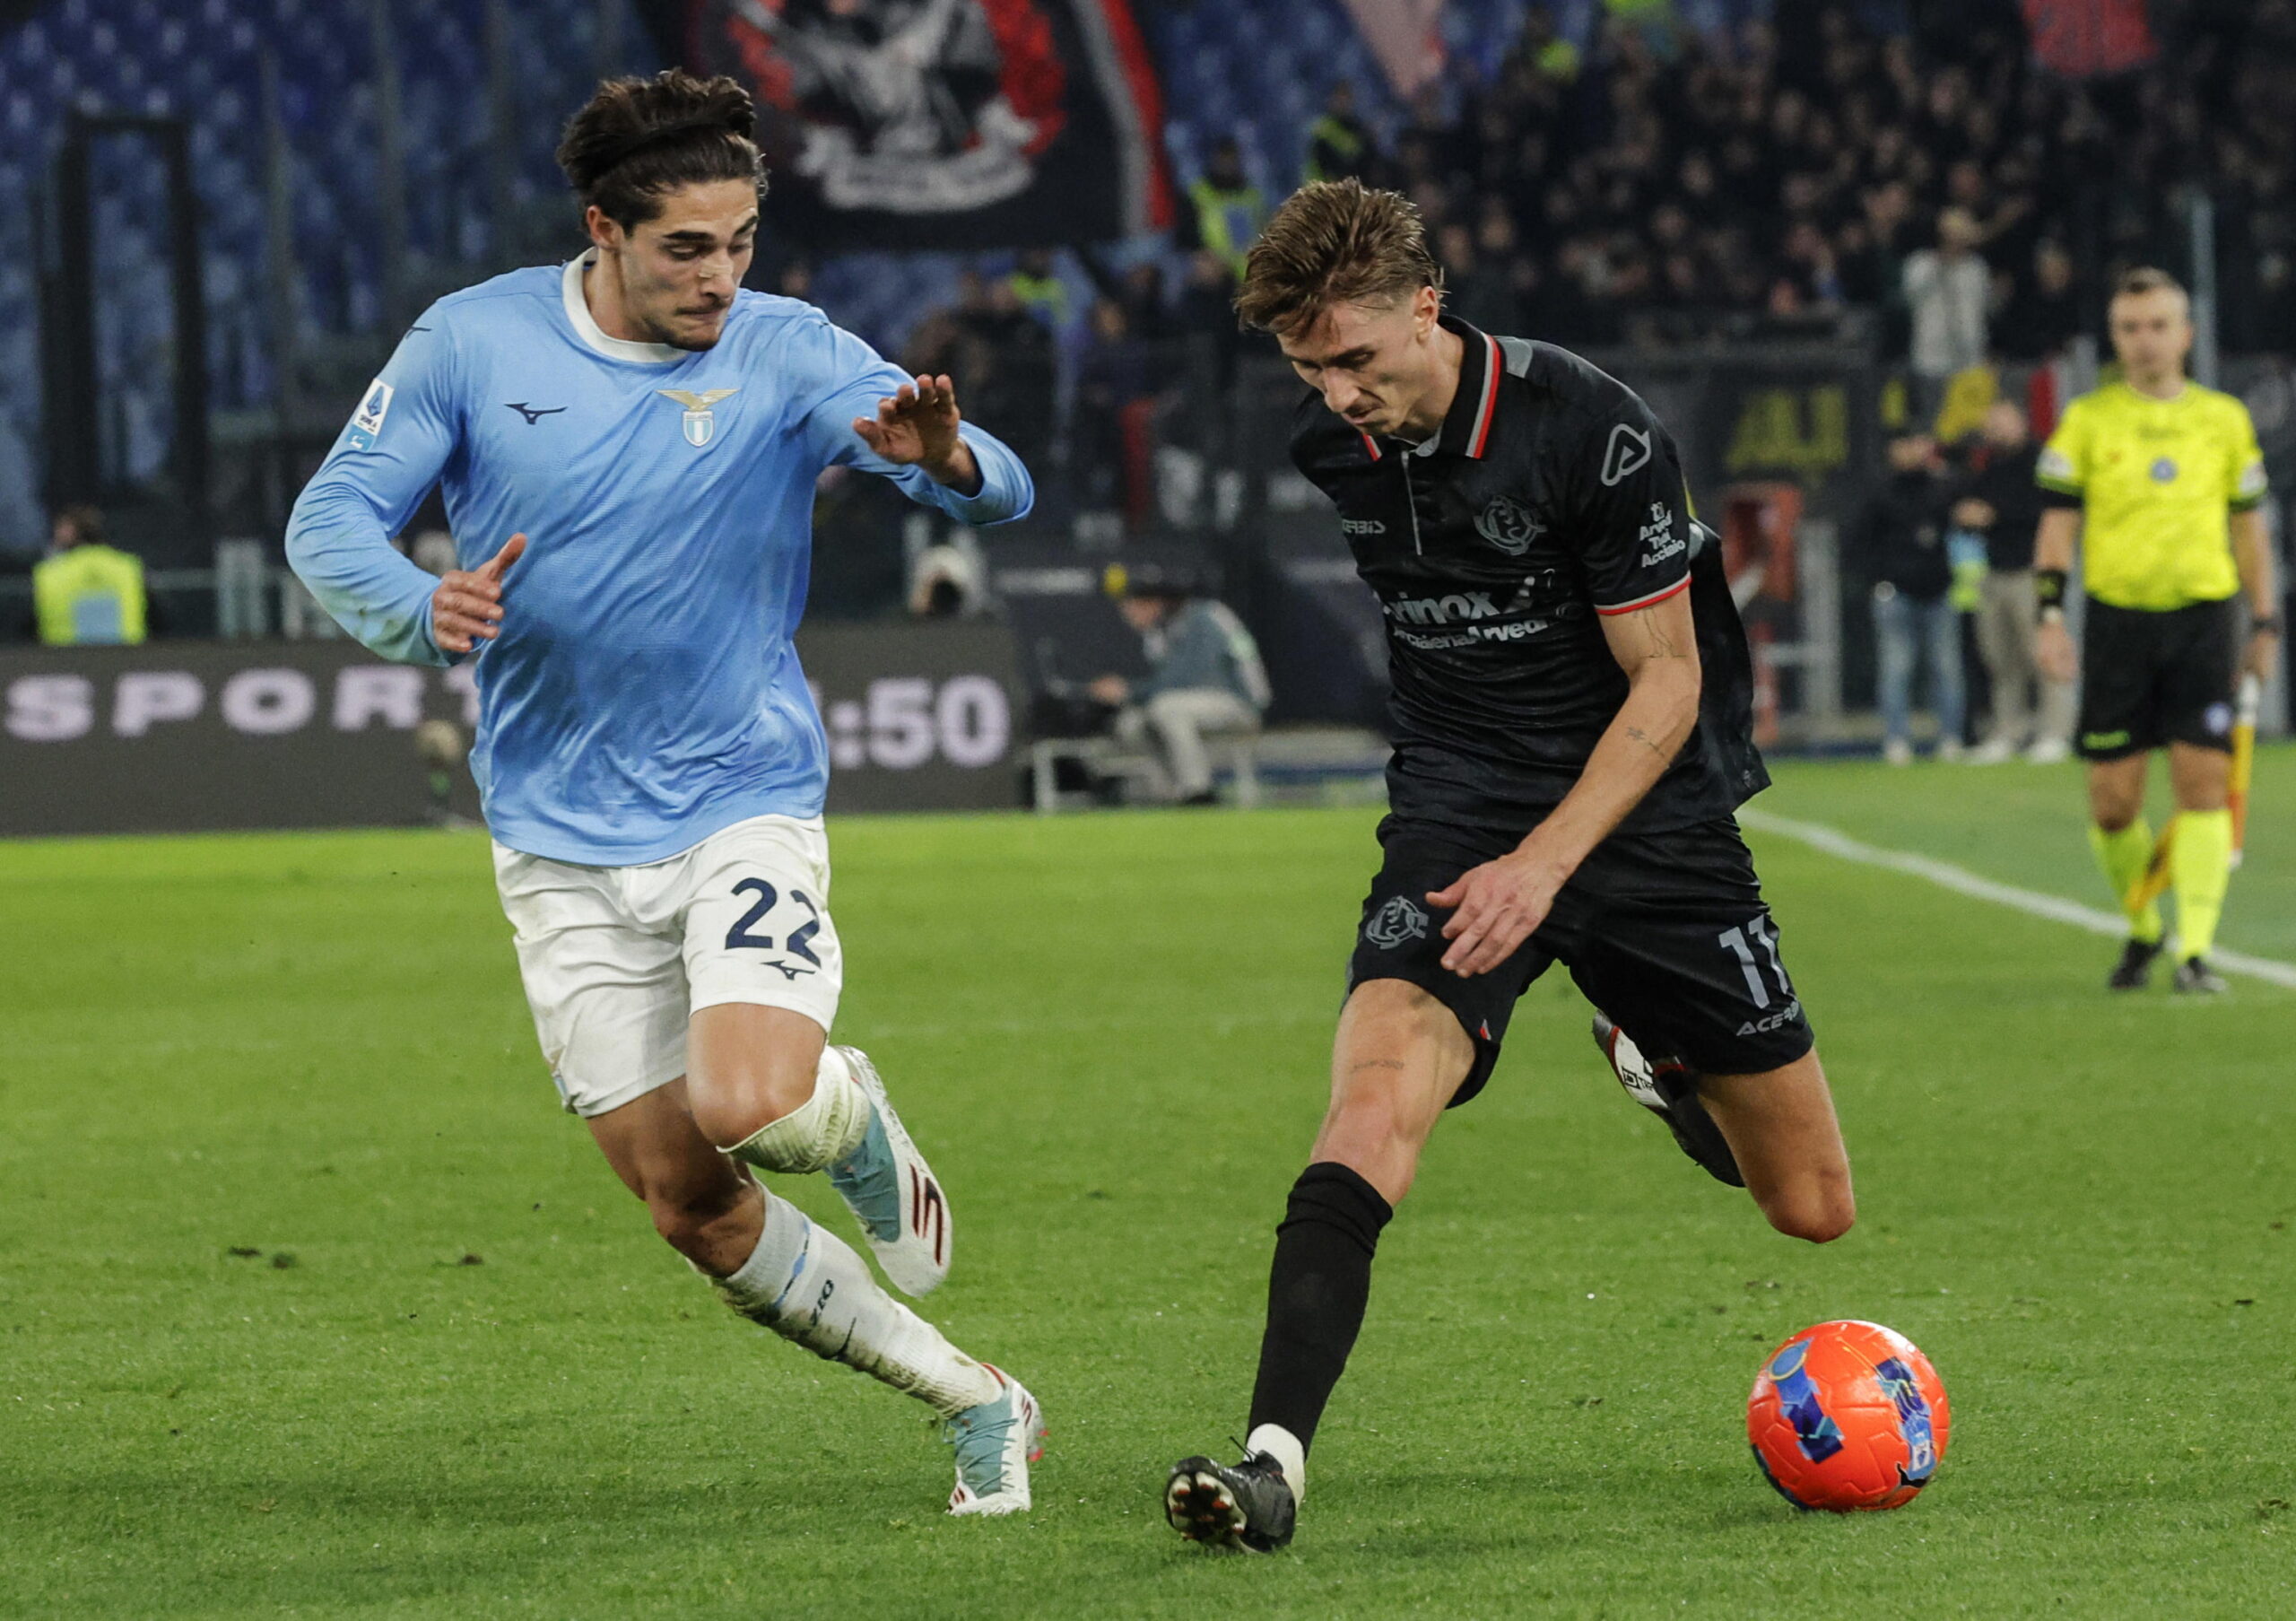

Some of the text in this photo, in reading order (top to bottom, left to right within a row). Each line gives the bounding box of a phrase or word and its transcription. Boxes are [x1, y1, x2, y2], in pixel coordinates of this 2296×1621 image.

[1383, 591, 1500, 625] rinox
[724, 876, 822, 971] 22
[1718, 913, 1789, 1009] 11
